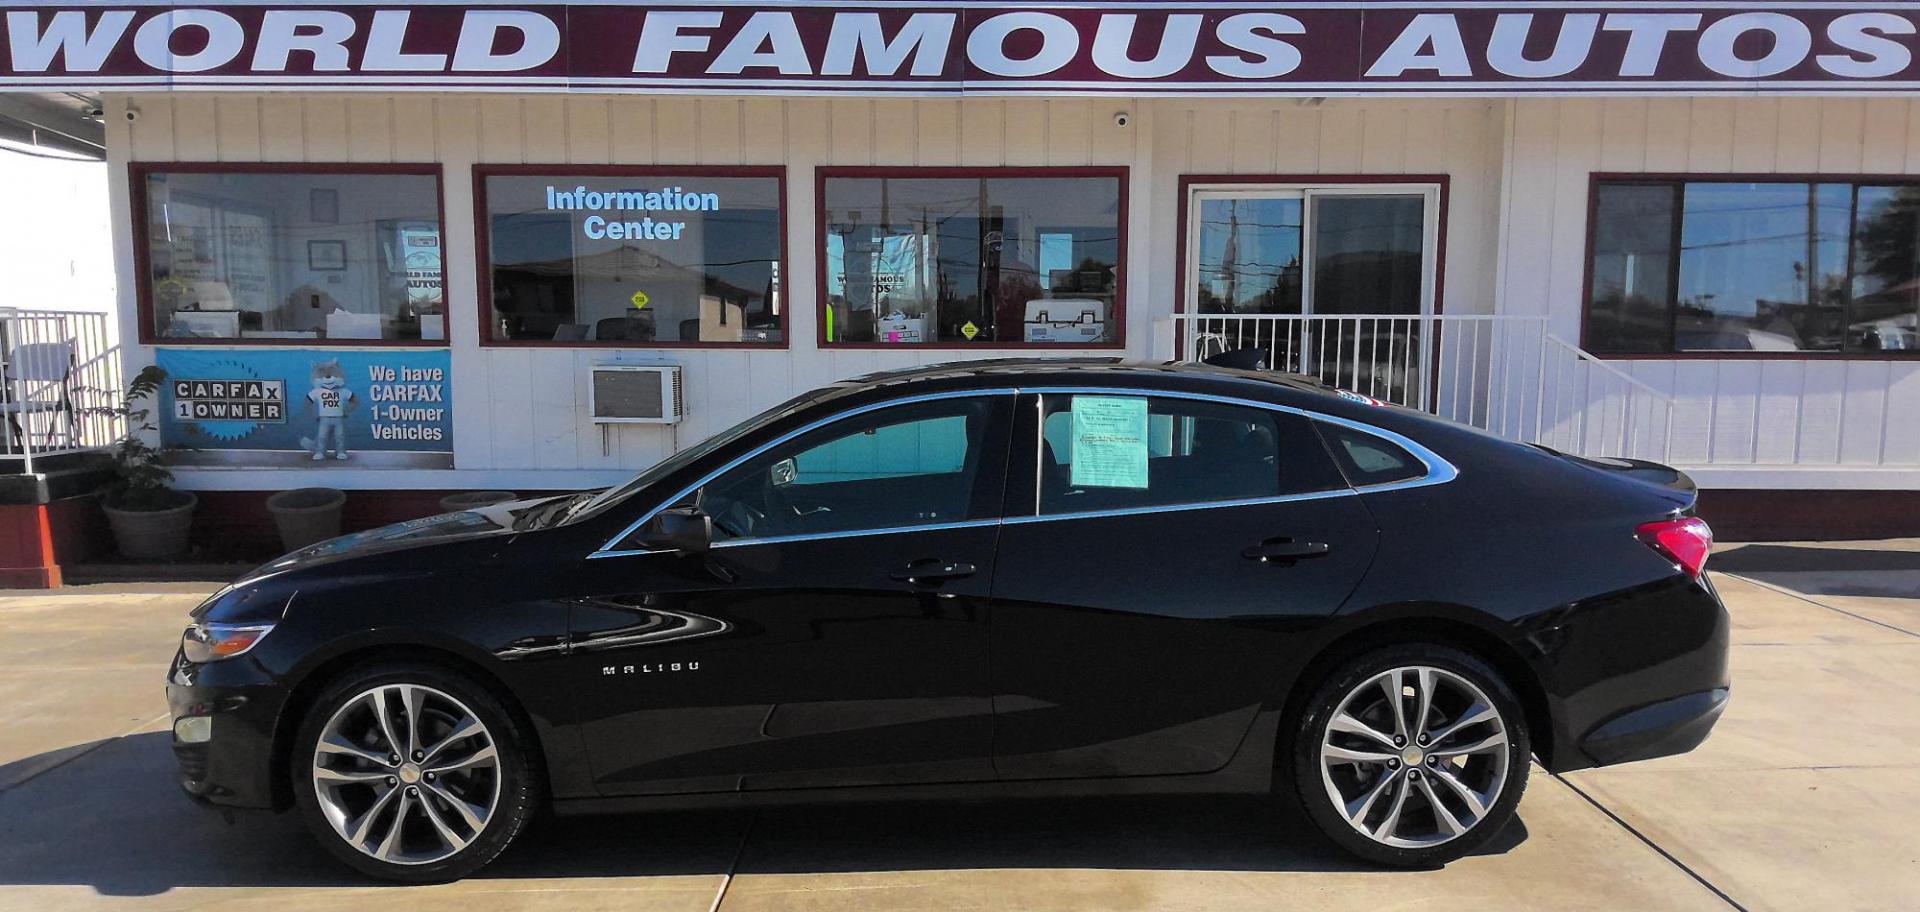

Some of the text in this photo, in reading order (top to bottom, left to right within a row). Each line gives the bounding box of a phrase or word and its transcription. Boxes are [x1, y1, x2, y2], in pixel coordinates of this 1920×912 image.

[5, 9, 1918, 79] WORLD FAMOUS AUTOS
[546, 186, 720, 212] Information
[583, 215, 686, 240] Center
[368, 365, 443, 382] We have
[177, 382, 279, 400] CARFAX
[321, 392, 340, 400] CAR
[369, 384, 443, 402] CARFAX
[179, 403, 280, 418] 1 OWNER
[322, 400, 340, 408] FOX
[370, 404, 444, 421] 1-Owner
[370, 423, 443, 440] Vehicles
[602, 661, 699, 676] MALIBU
